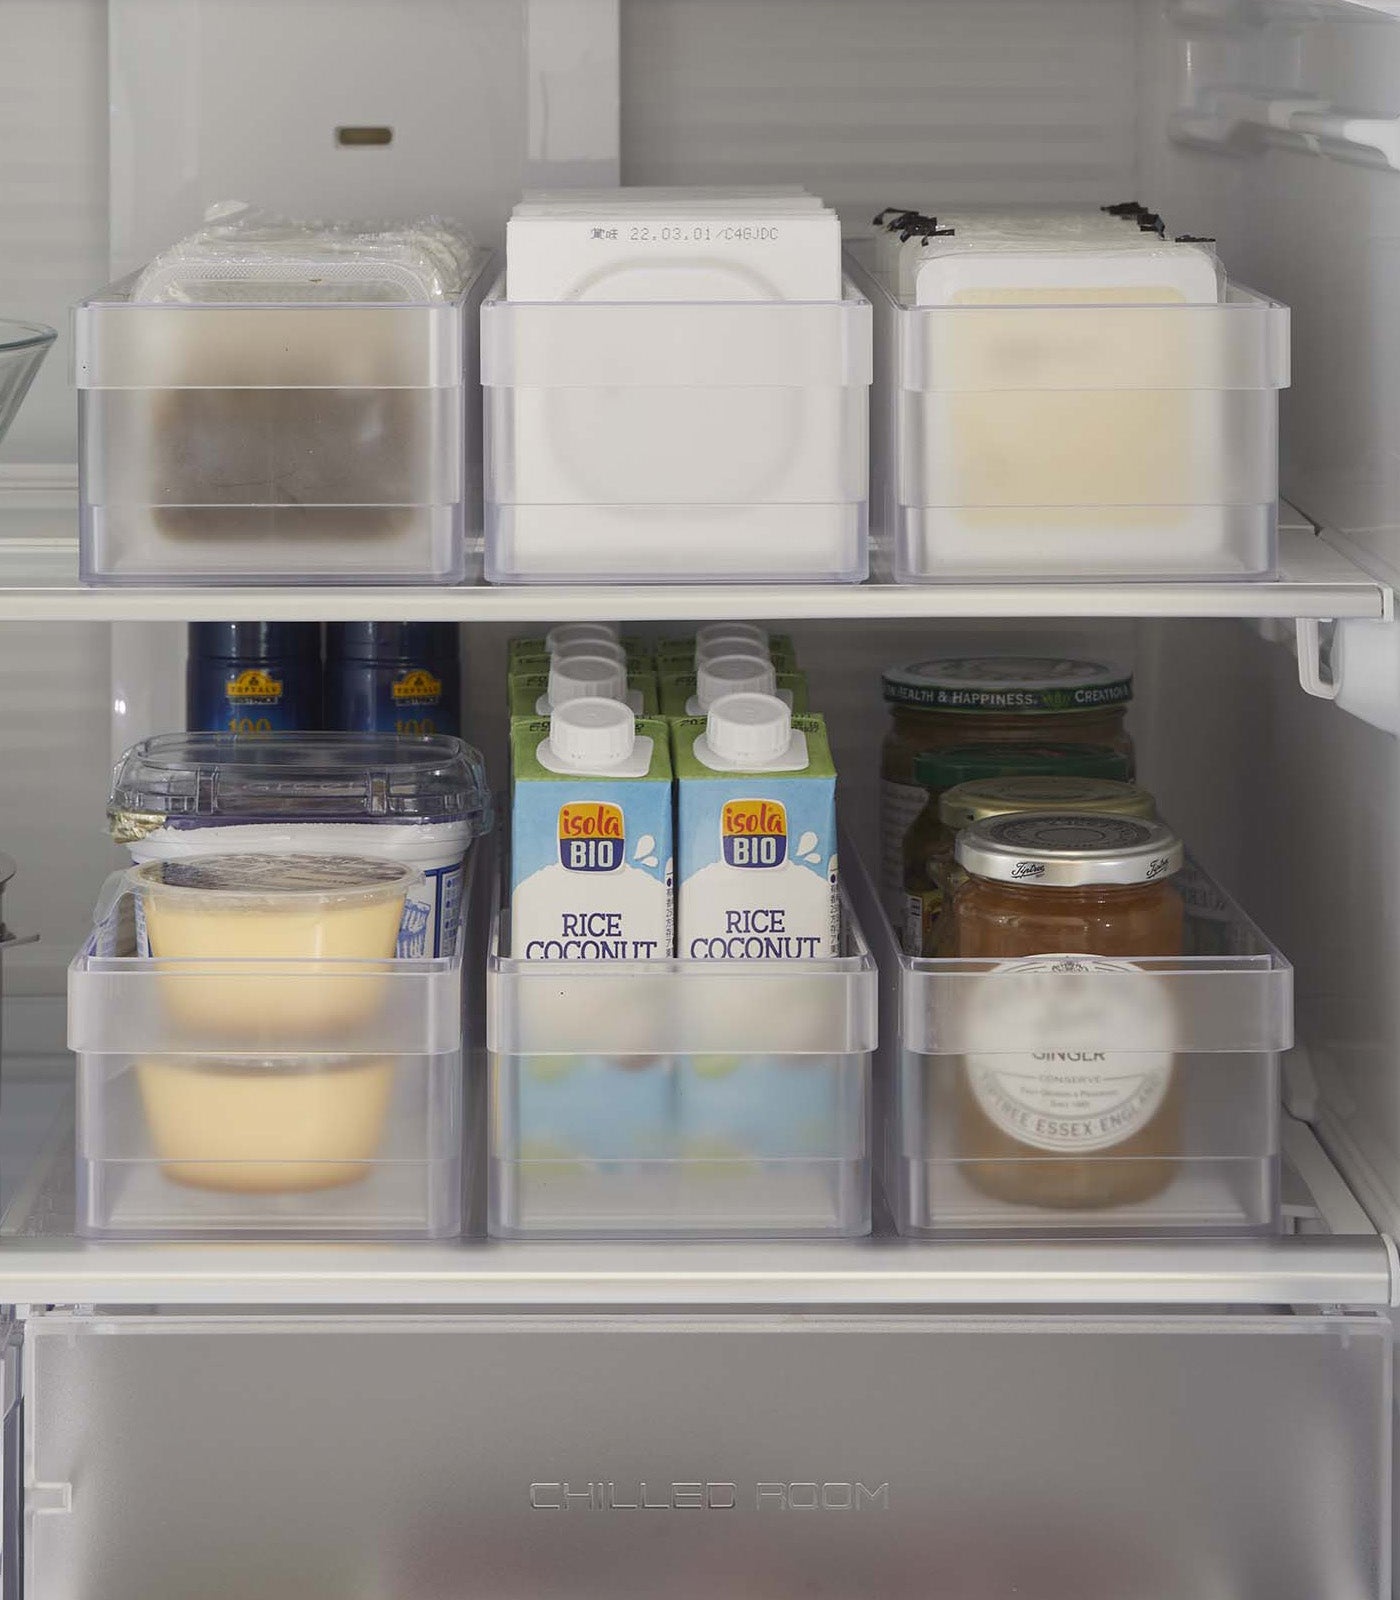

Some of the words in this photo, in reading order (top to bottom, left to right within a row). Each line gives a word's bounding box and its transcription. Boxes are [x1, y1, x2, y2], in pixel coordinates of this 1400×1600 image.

[938, 691, 948, 703] &
[562, 804, 622, 837] isola
[726, 802, 784, 836] isola
[570, 840, 614, 869] BIO
[733, 837, 777, 866] BIO
[562, 913, 622, 938] RICE
[725, 909, 786, 934] RICE
[526, 940, 658, 960] COCONUT
[690, 936, 821, 959] COCONUT
[1035, 1118, 1094, 1137] ESSEX
[529, 1482, 737, 1511] CHILLED
[756, 1482, 890, 1511] ROOM
